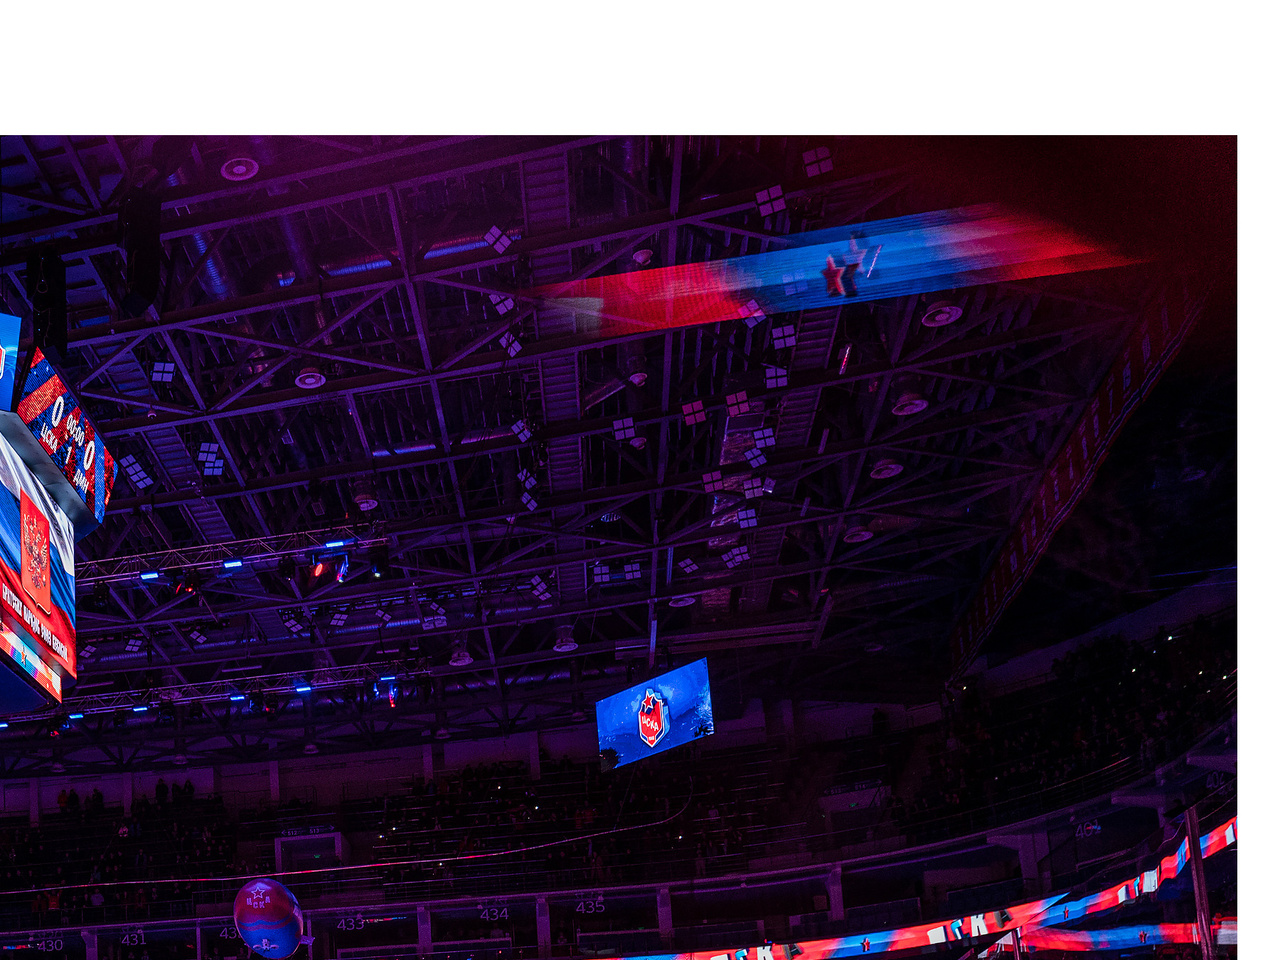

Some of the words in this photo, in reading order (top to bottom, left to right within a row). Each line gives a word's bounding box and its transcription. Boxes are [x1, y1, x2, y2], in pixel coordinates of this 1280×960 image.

[52, 396, 64, 427] 0
[40, 422, 58, 453] ЦСКА
[83, 440, 95, 471] 0
[72, 468, 89, 494] ДМН
[641, 715, 659, 731] ЦСКА
[479, 907, 509, 921] 434
[575, 901, 606, 914] 435
[336, 917, 365, 931] 433
[121, 932, 146, 946] 431
[220, 927, 238, 940] 43
[37, 939, 63, 952] 430
